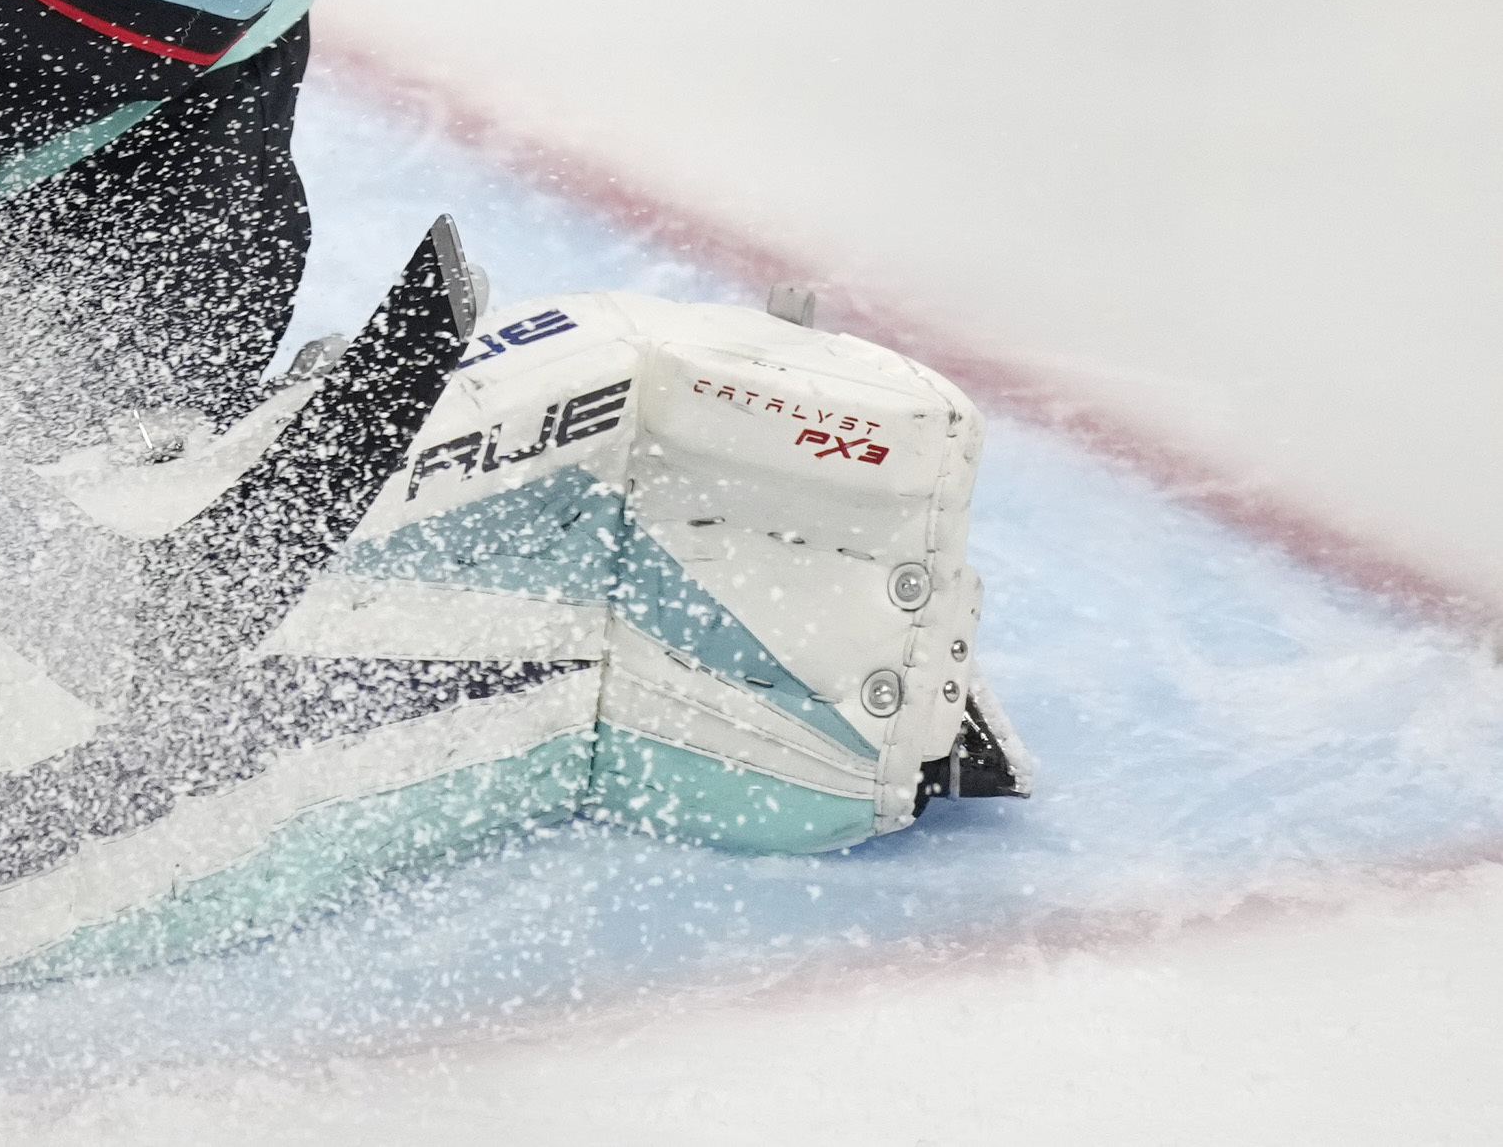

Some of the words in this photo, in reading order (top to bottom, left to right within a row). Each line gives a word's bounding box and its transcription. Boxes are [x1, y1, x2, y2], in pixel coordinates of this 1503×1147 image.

[693, 380, 881, 435] CATALYST
[402, 378, 632, 502] RUE
[794, 428, 890, 466] PX3
